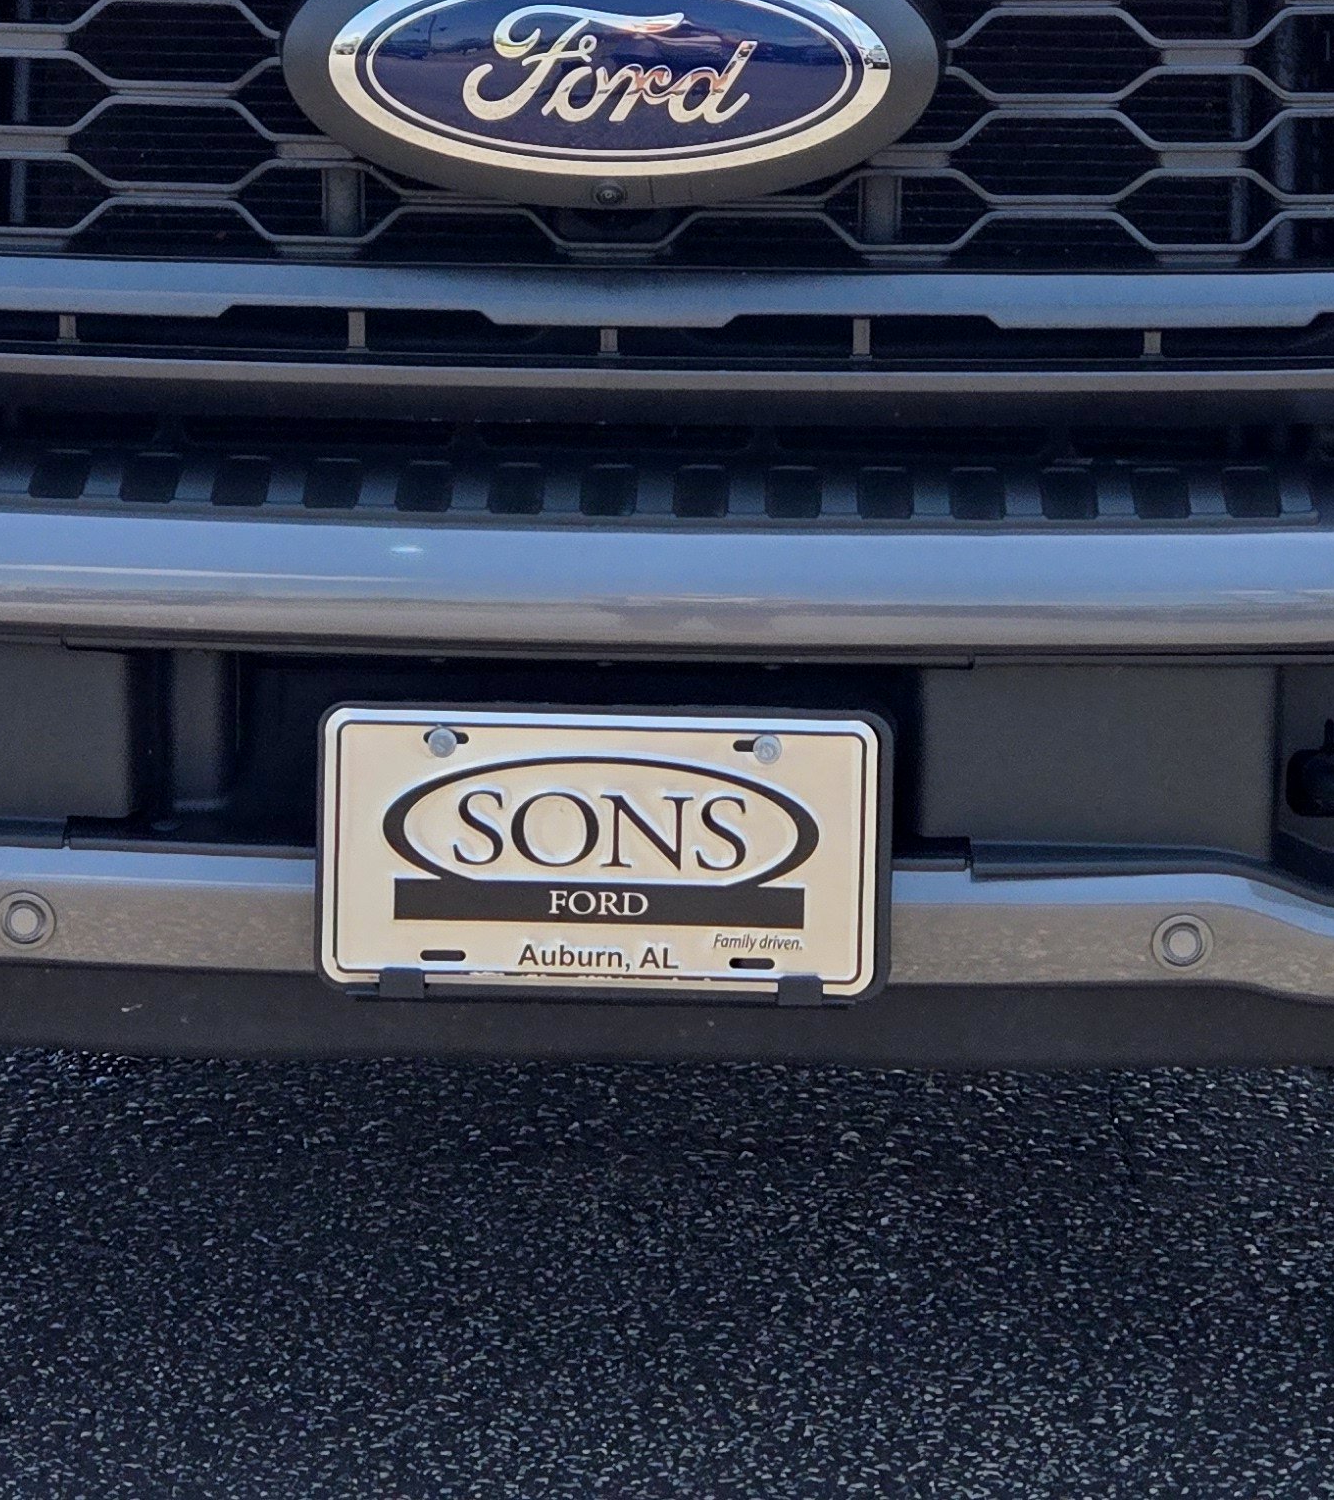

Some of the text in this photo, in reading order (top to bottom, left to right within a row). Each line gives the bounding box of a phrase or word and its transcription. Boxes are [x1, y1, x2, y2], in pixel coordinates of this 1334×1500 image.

[462, 4, 758, 124] Ford
[452, 789, 747, 871] SONS
[548, 890, 649, 916] FORD
[713, 933, 803, 953] Family driven.
[517, 944, 679, 972] Auburn, AL
